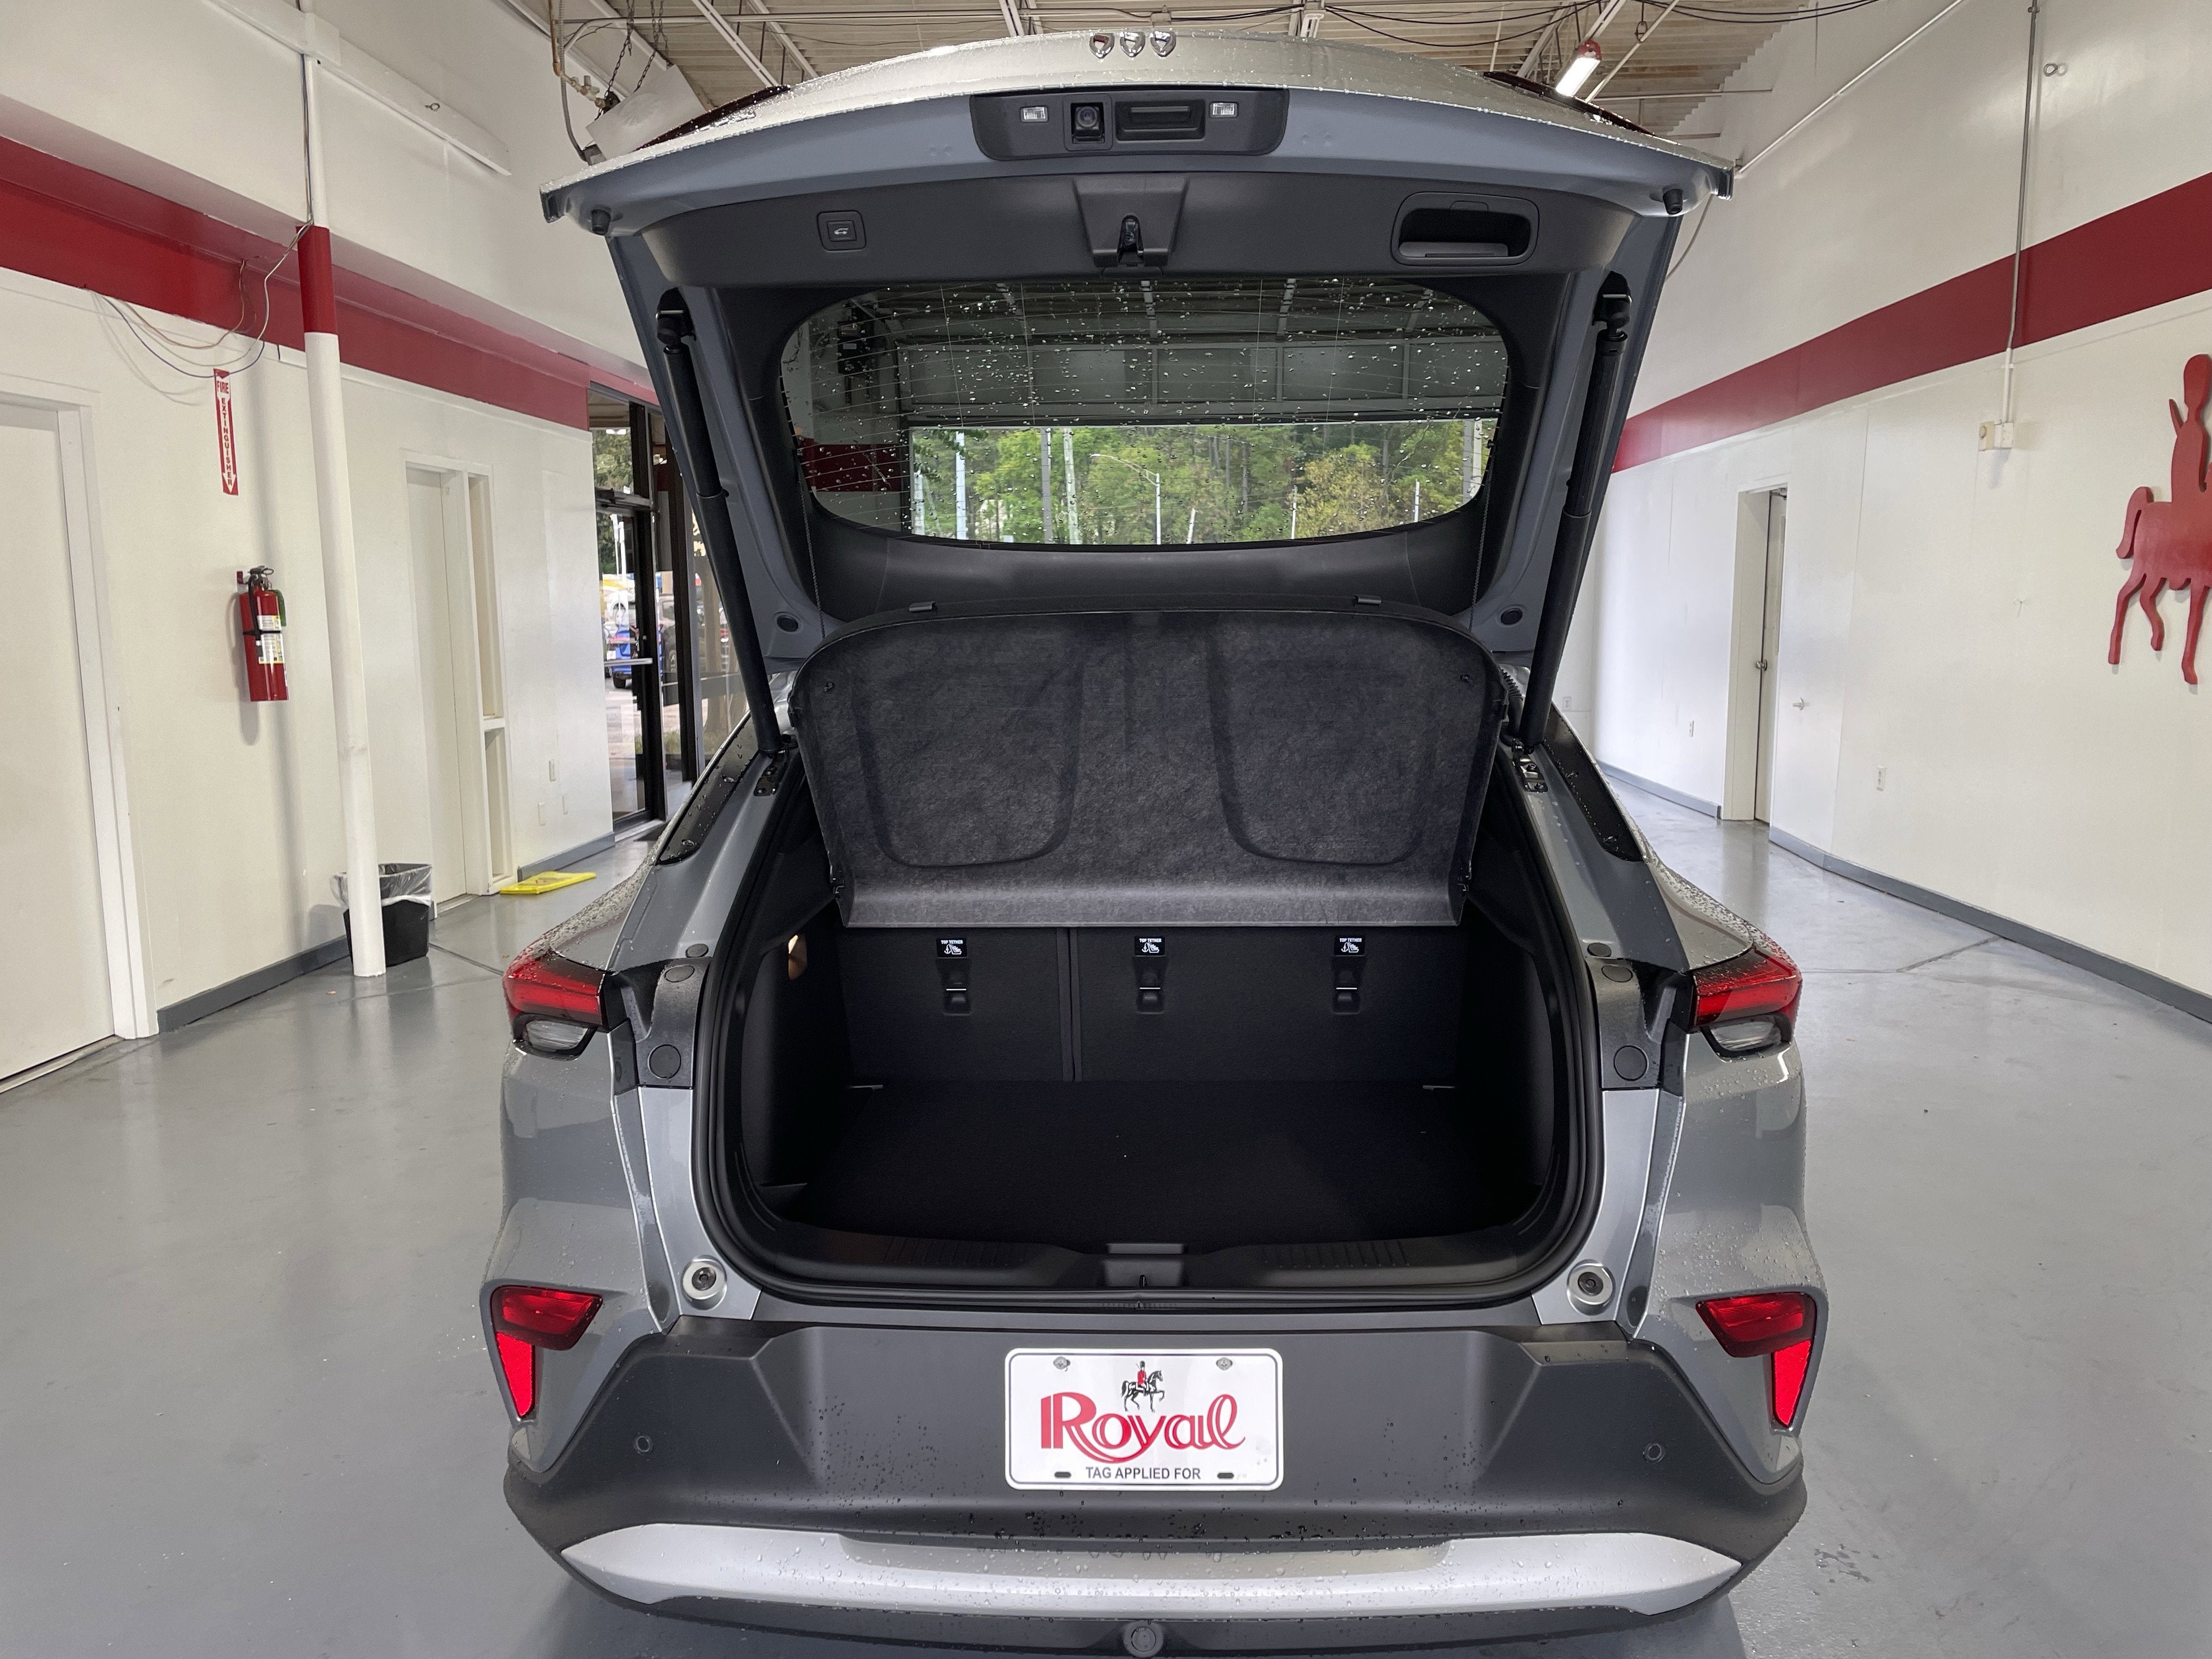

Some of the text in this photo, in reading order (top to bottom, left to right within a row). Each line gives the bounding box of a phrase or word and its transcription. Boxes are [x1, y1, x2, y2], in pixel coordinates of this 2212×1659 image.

[217, 381, 229, 394] FIRE
[221, 397, 233, 486] EXTINGUISHER
[1041, 1392, 1245, 1463] Royal
[1085, 1466, 1201, 1480] TAG APPLIED FOR
